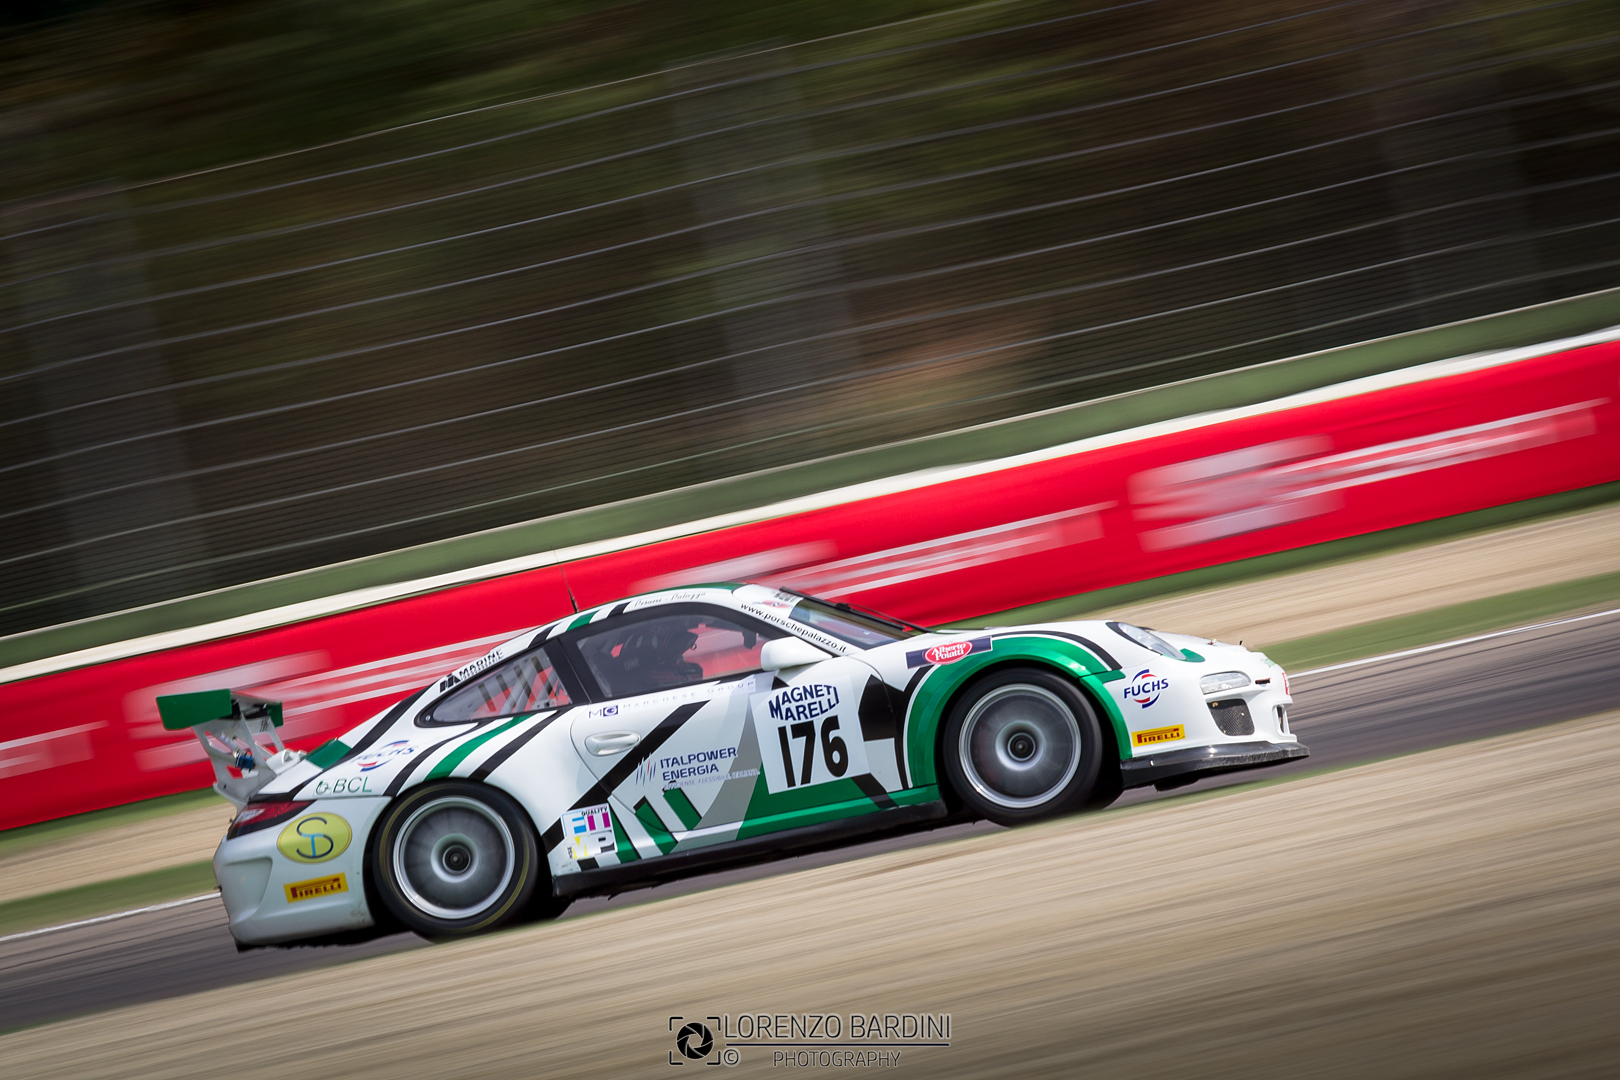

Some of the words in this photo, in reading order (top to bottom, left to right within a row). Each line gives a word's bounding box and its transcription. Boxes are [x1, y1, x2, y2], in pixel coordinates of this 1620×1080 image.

[740, 603, 847, 653] www.porschepalazzo.it
[931, 642, 966, 656] Alberto
[1123, 678, 1170, 700] FUCHS
[1136, 727, 1181, 745] PIRELLI
[660, 746, 738, 769] ITALPOWER
[777, 714, 849, 789] 176
[662, 763, 720, 781] ENERGIA
[581, 806, 608, 817] QUALITY
[290, 877, 342, 900] PIRELLI
